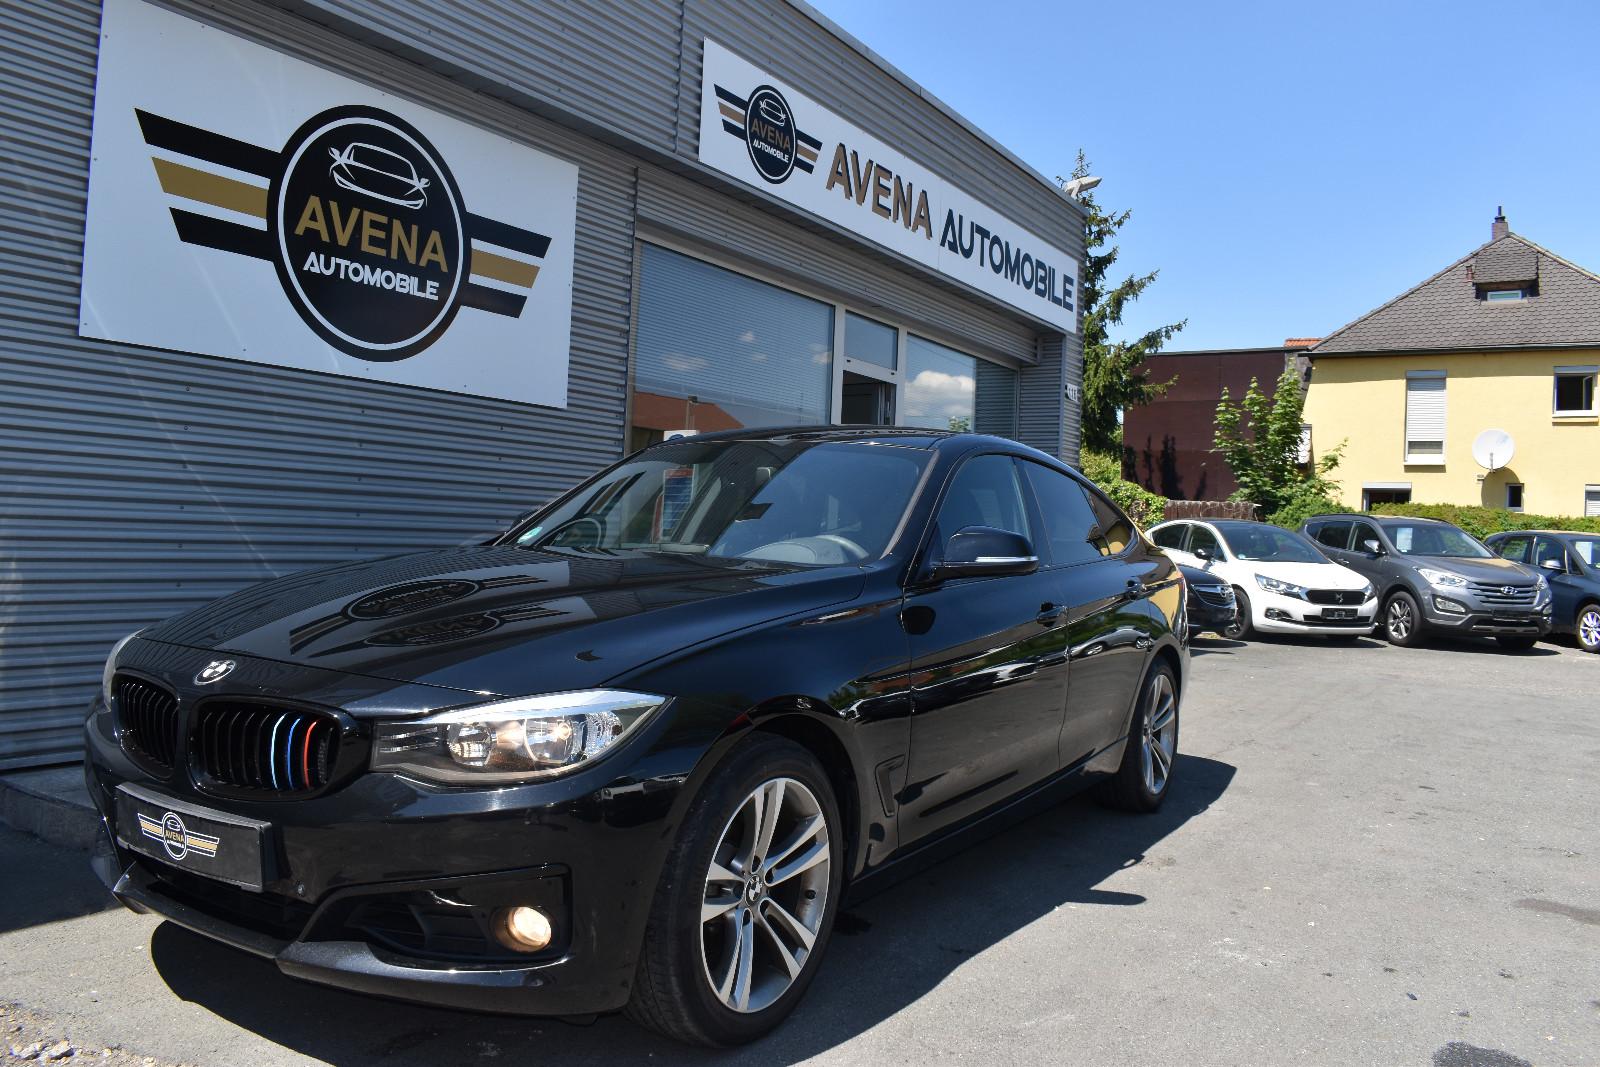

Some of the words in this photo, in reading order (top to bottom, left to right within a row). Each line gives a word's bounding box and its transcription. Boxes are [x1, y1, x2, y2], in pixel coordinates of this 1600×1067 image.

[751, 118, 791, 152] AVENA
[753, 138, 789, 163] AUTOMOBILE
[294, 194, 449, 273] AVENA
[826, 143, 933, 240] AVENA
[940, 208, 1074, 312] AUTOMOBILE
[302, 251, 440, 301] AUTOMOBILE
[165, 829, 185, 843] AVENA
